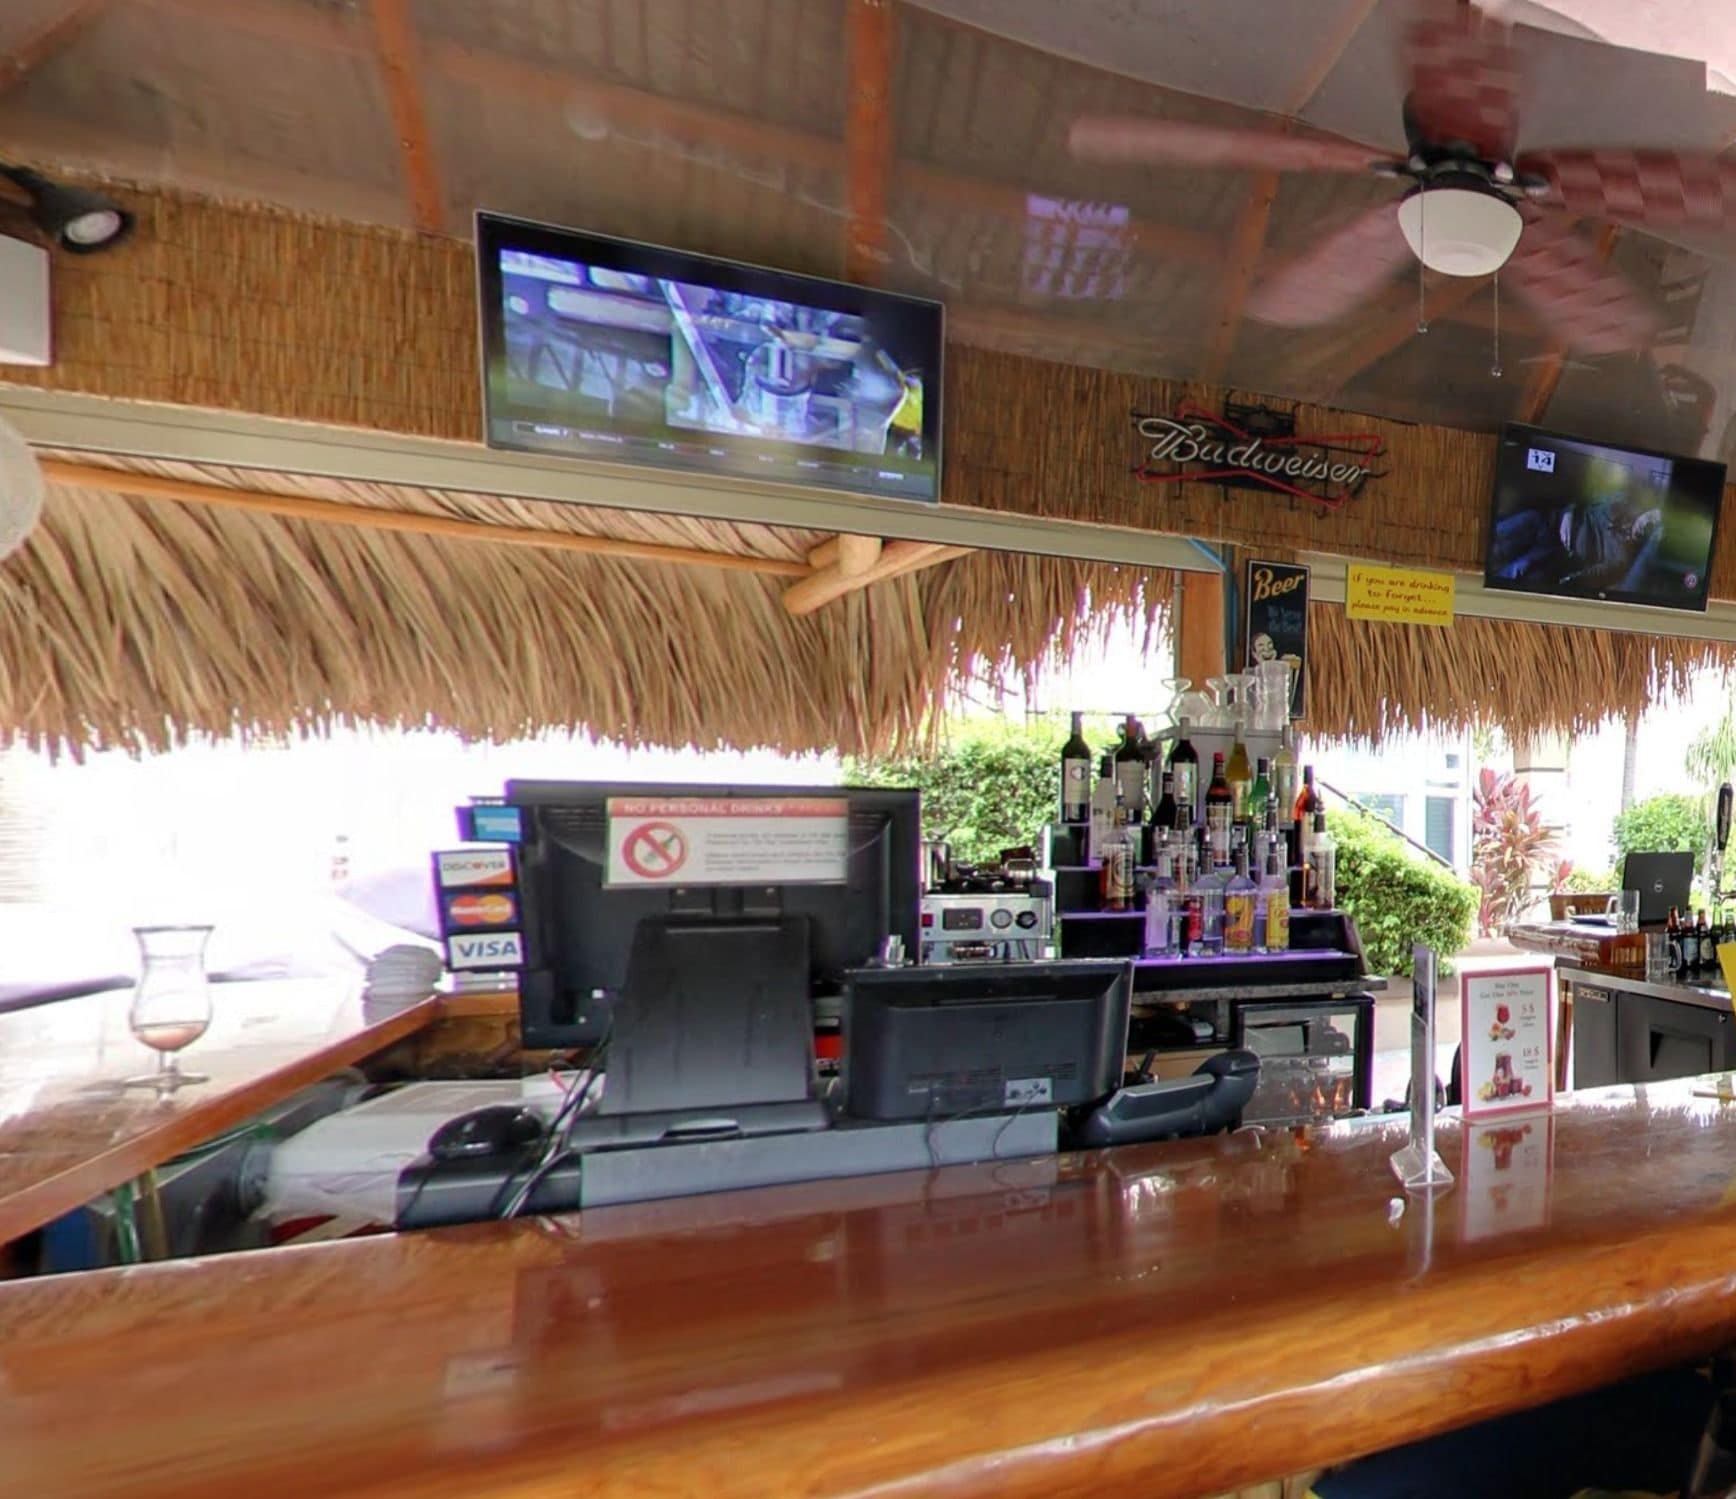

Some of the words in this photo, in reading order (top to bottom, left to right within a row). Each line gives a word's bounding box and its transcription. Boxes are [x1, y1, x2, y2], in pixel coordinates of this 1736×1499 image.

[1138, 417, 1370, 485] Budweiser
[1254, 568, 1305, 601] Beer
[1366, 577, 1385, 586] you
[1409, 580, 1450, 593] drinking
[1367, 589, 1381, 598] to
[1351, 600, 1380, 609] please
[1383, 605, 1400, 614] pay
[624, 804, 647, 814] NO
[650, 803, 728, 814] PERSONAL
[731, 803, 783, 814] DRINKS
[457, 941, 518, 958] VISA
